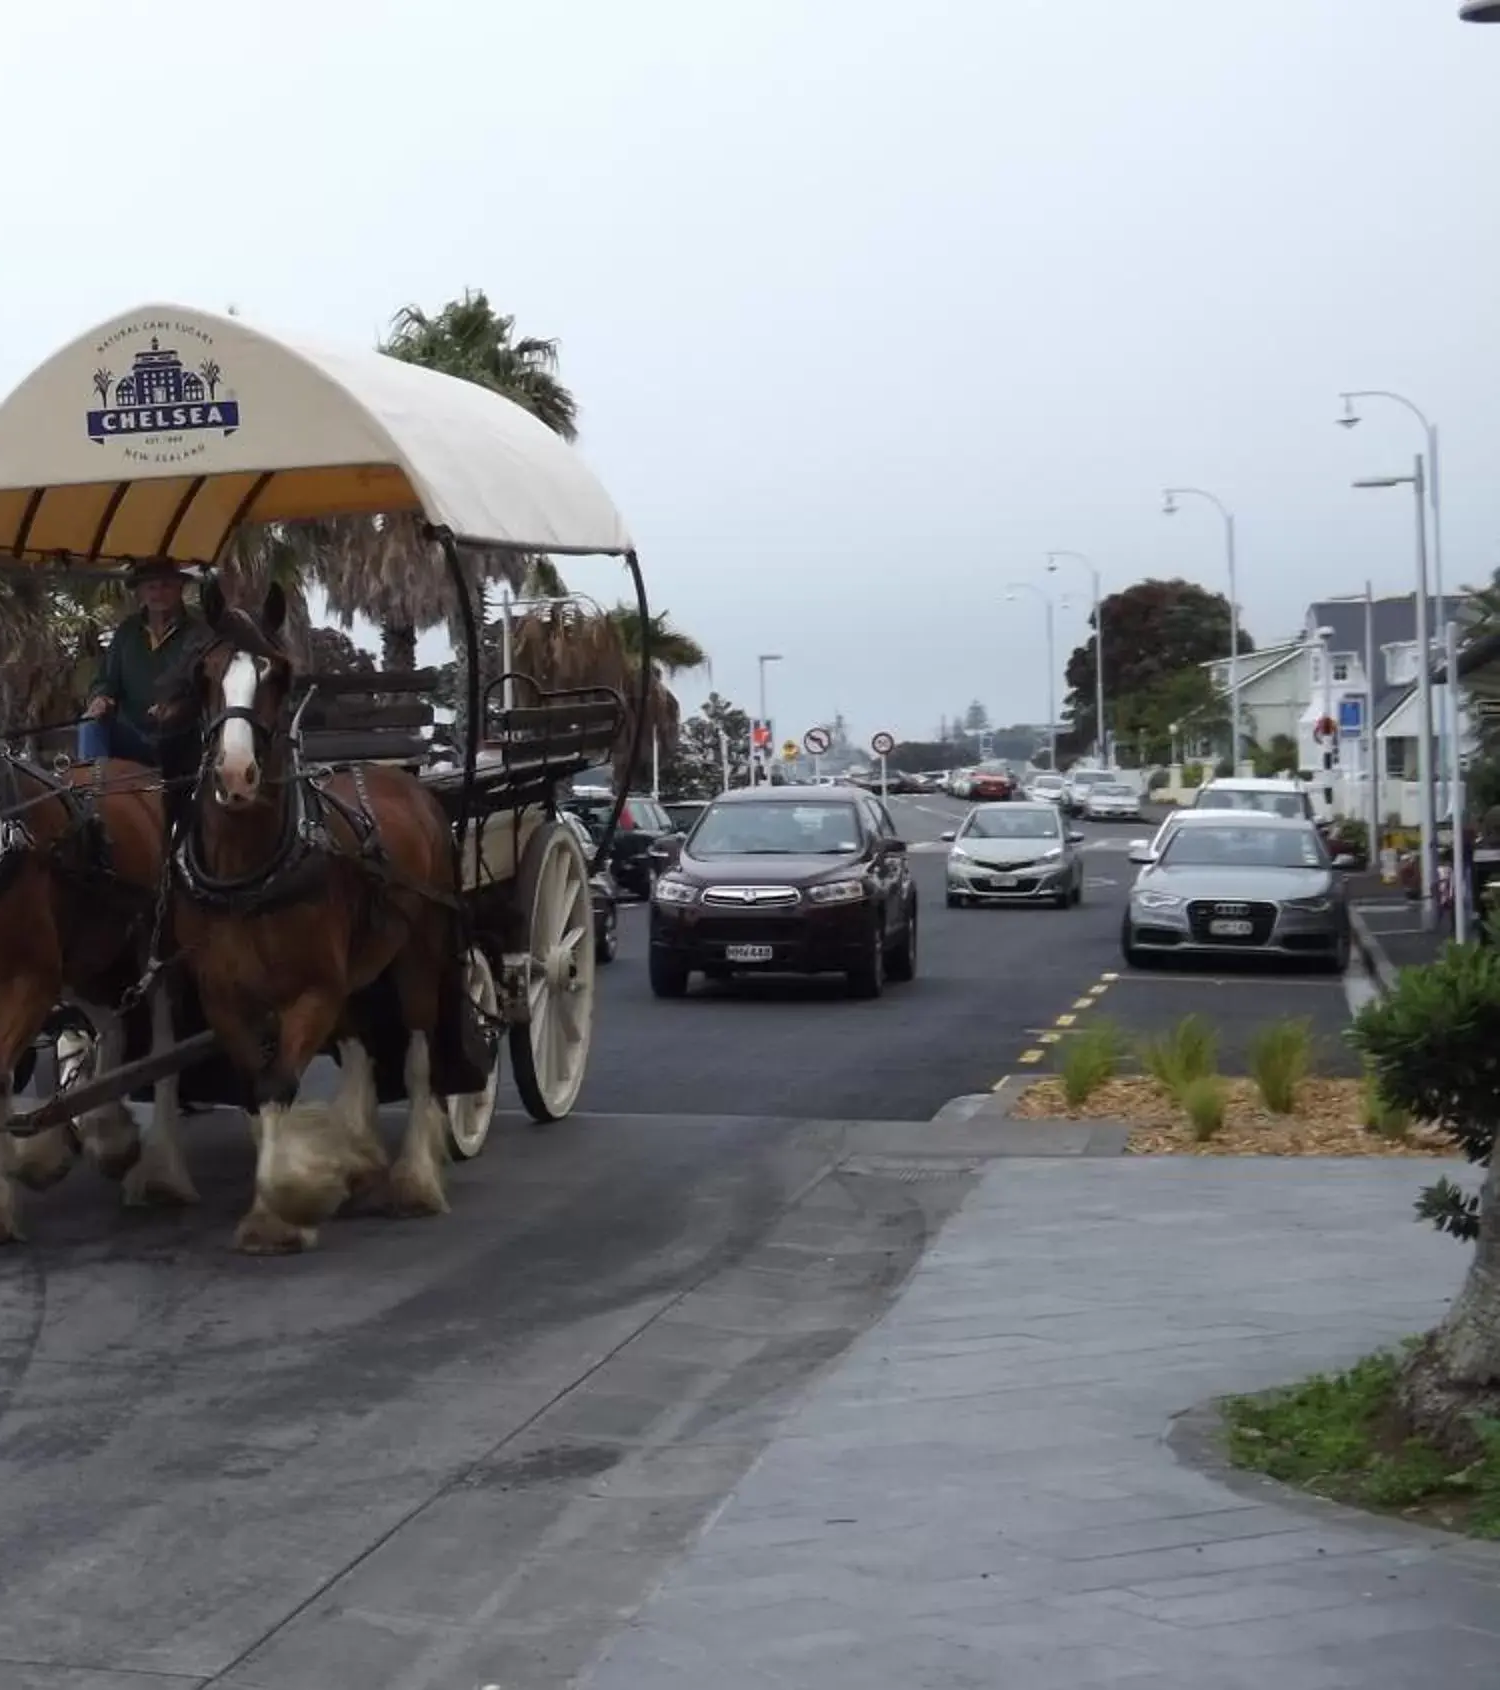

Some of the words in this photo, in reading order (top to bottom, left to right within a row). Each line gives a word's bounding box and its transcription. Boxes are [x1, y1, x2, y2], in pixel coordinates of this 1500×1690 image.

[97, 324, 140, 351] NATURAL
[101, 406, 223, 430] CHELSEA
[125, 447, 148, 461] NEW
[155, 444, 205, 462] ZEALAND
